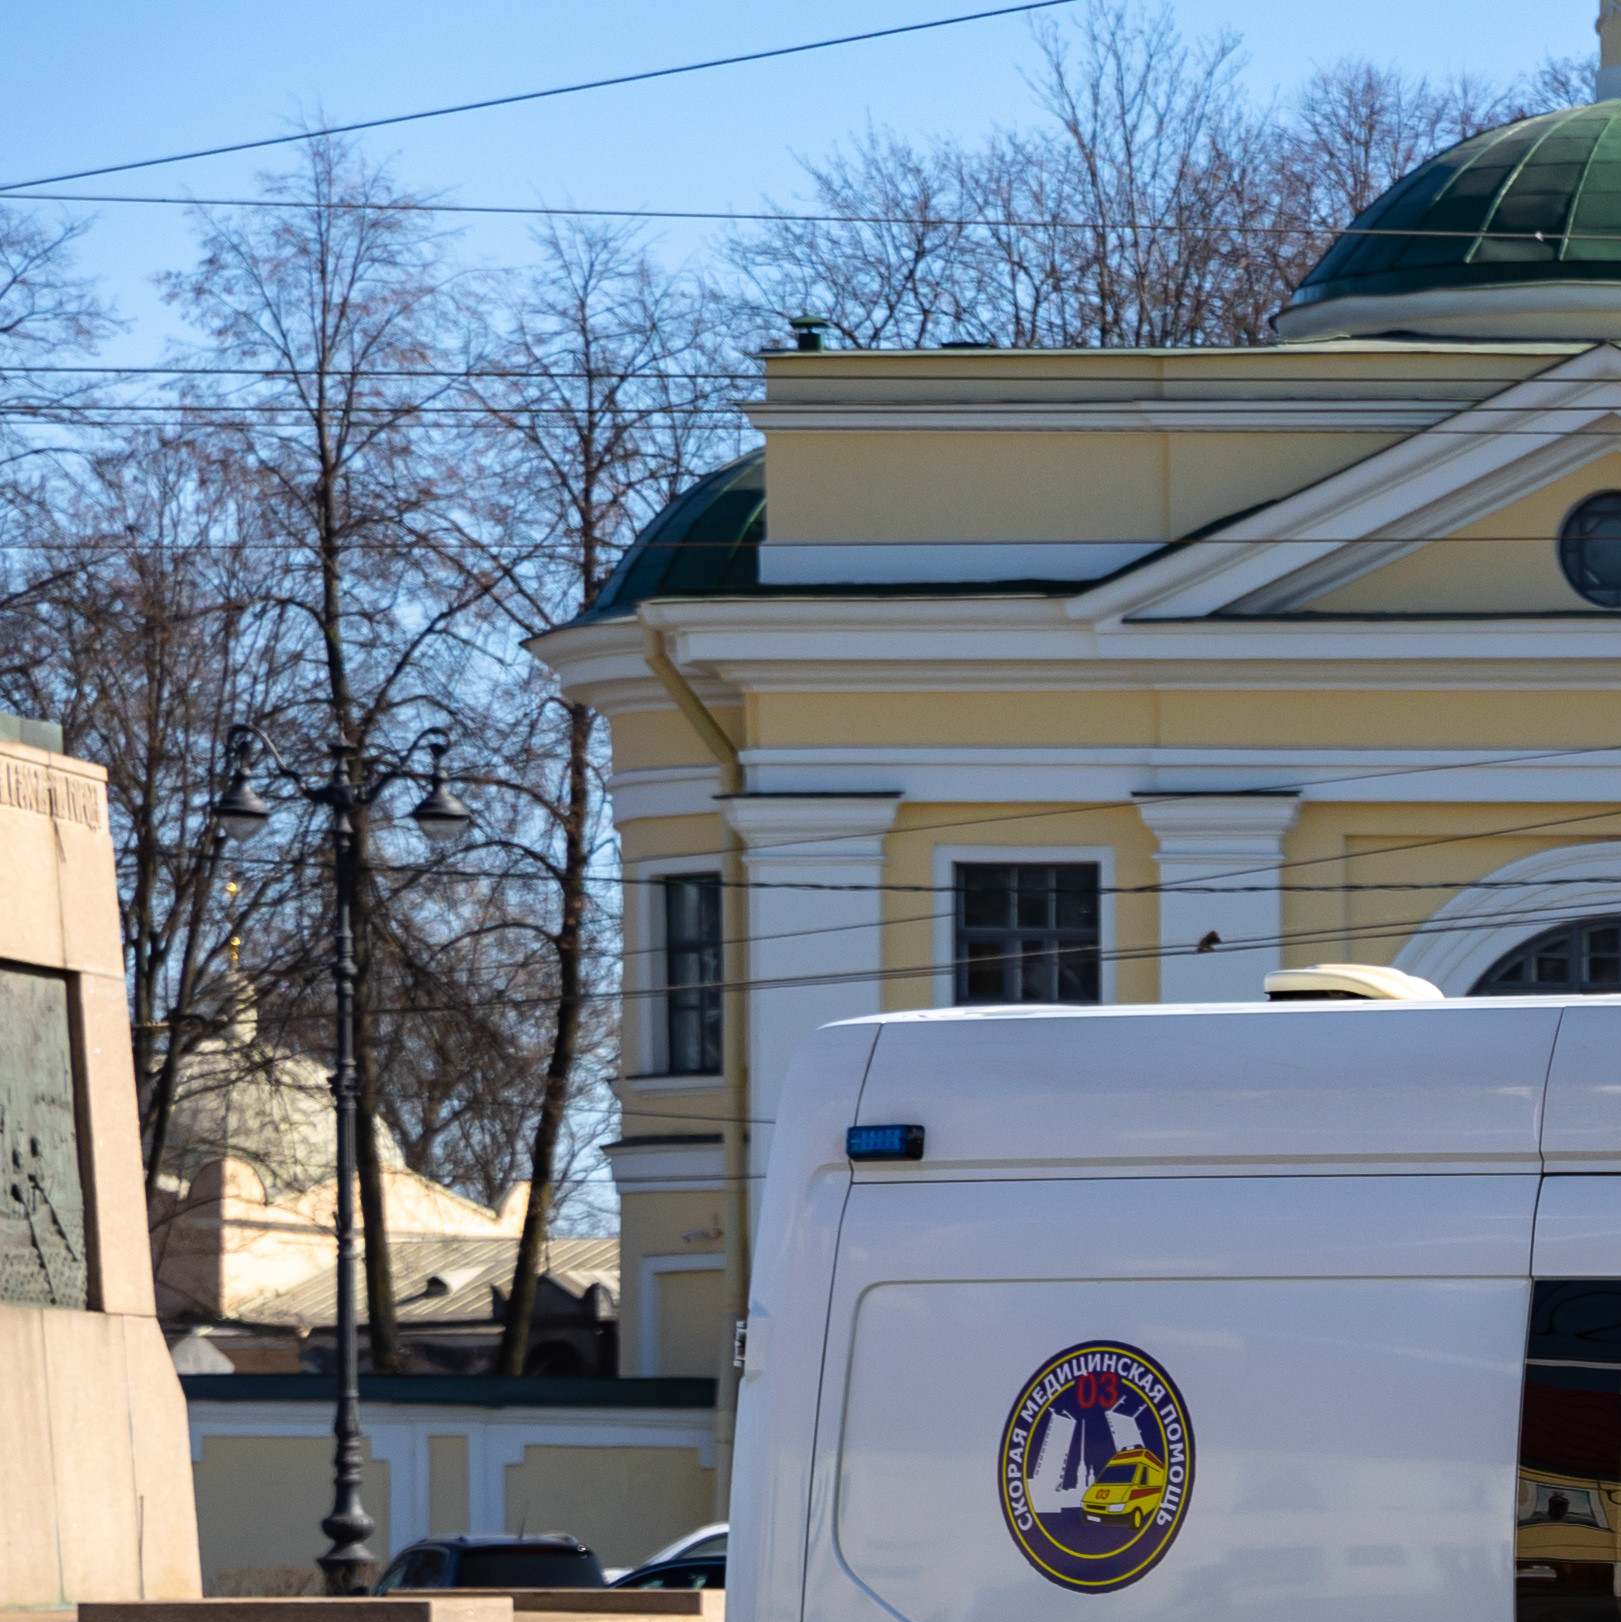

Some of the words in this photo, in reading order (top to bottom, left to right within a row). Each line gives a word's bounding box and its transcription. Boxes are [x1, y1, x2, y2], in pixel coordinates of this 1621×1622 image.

[1020, 1353, 1166, 1424] МЕДИЦИНСКАЯ
[1077, 1371, 1119, 1409] 03
[1008, 1428, 1034, 1531] СКОРАЯ
[1095, 1488, 1111, 1501] 03
[1155, 1403, 1185, 1526] ПОМОЩЬ
